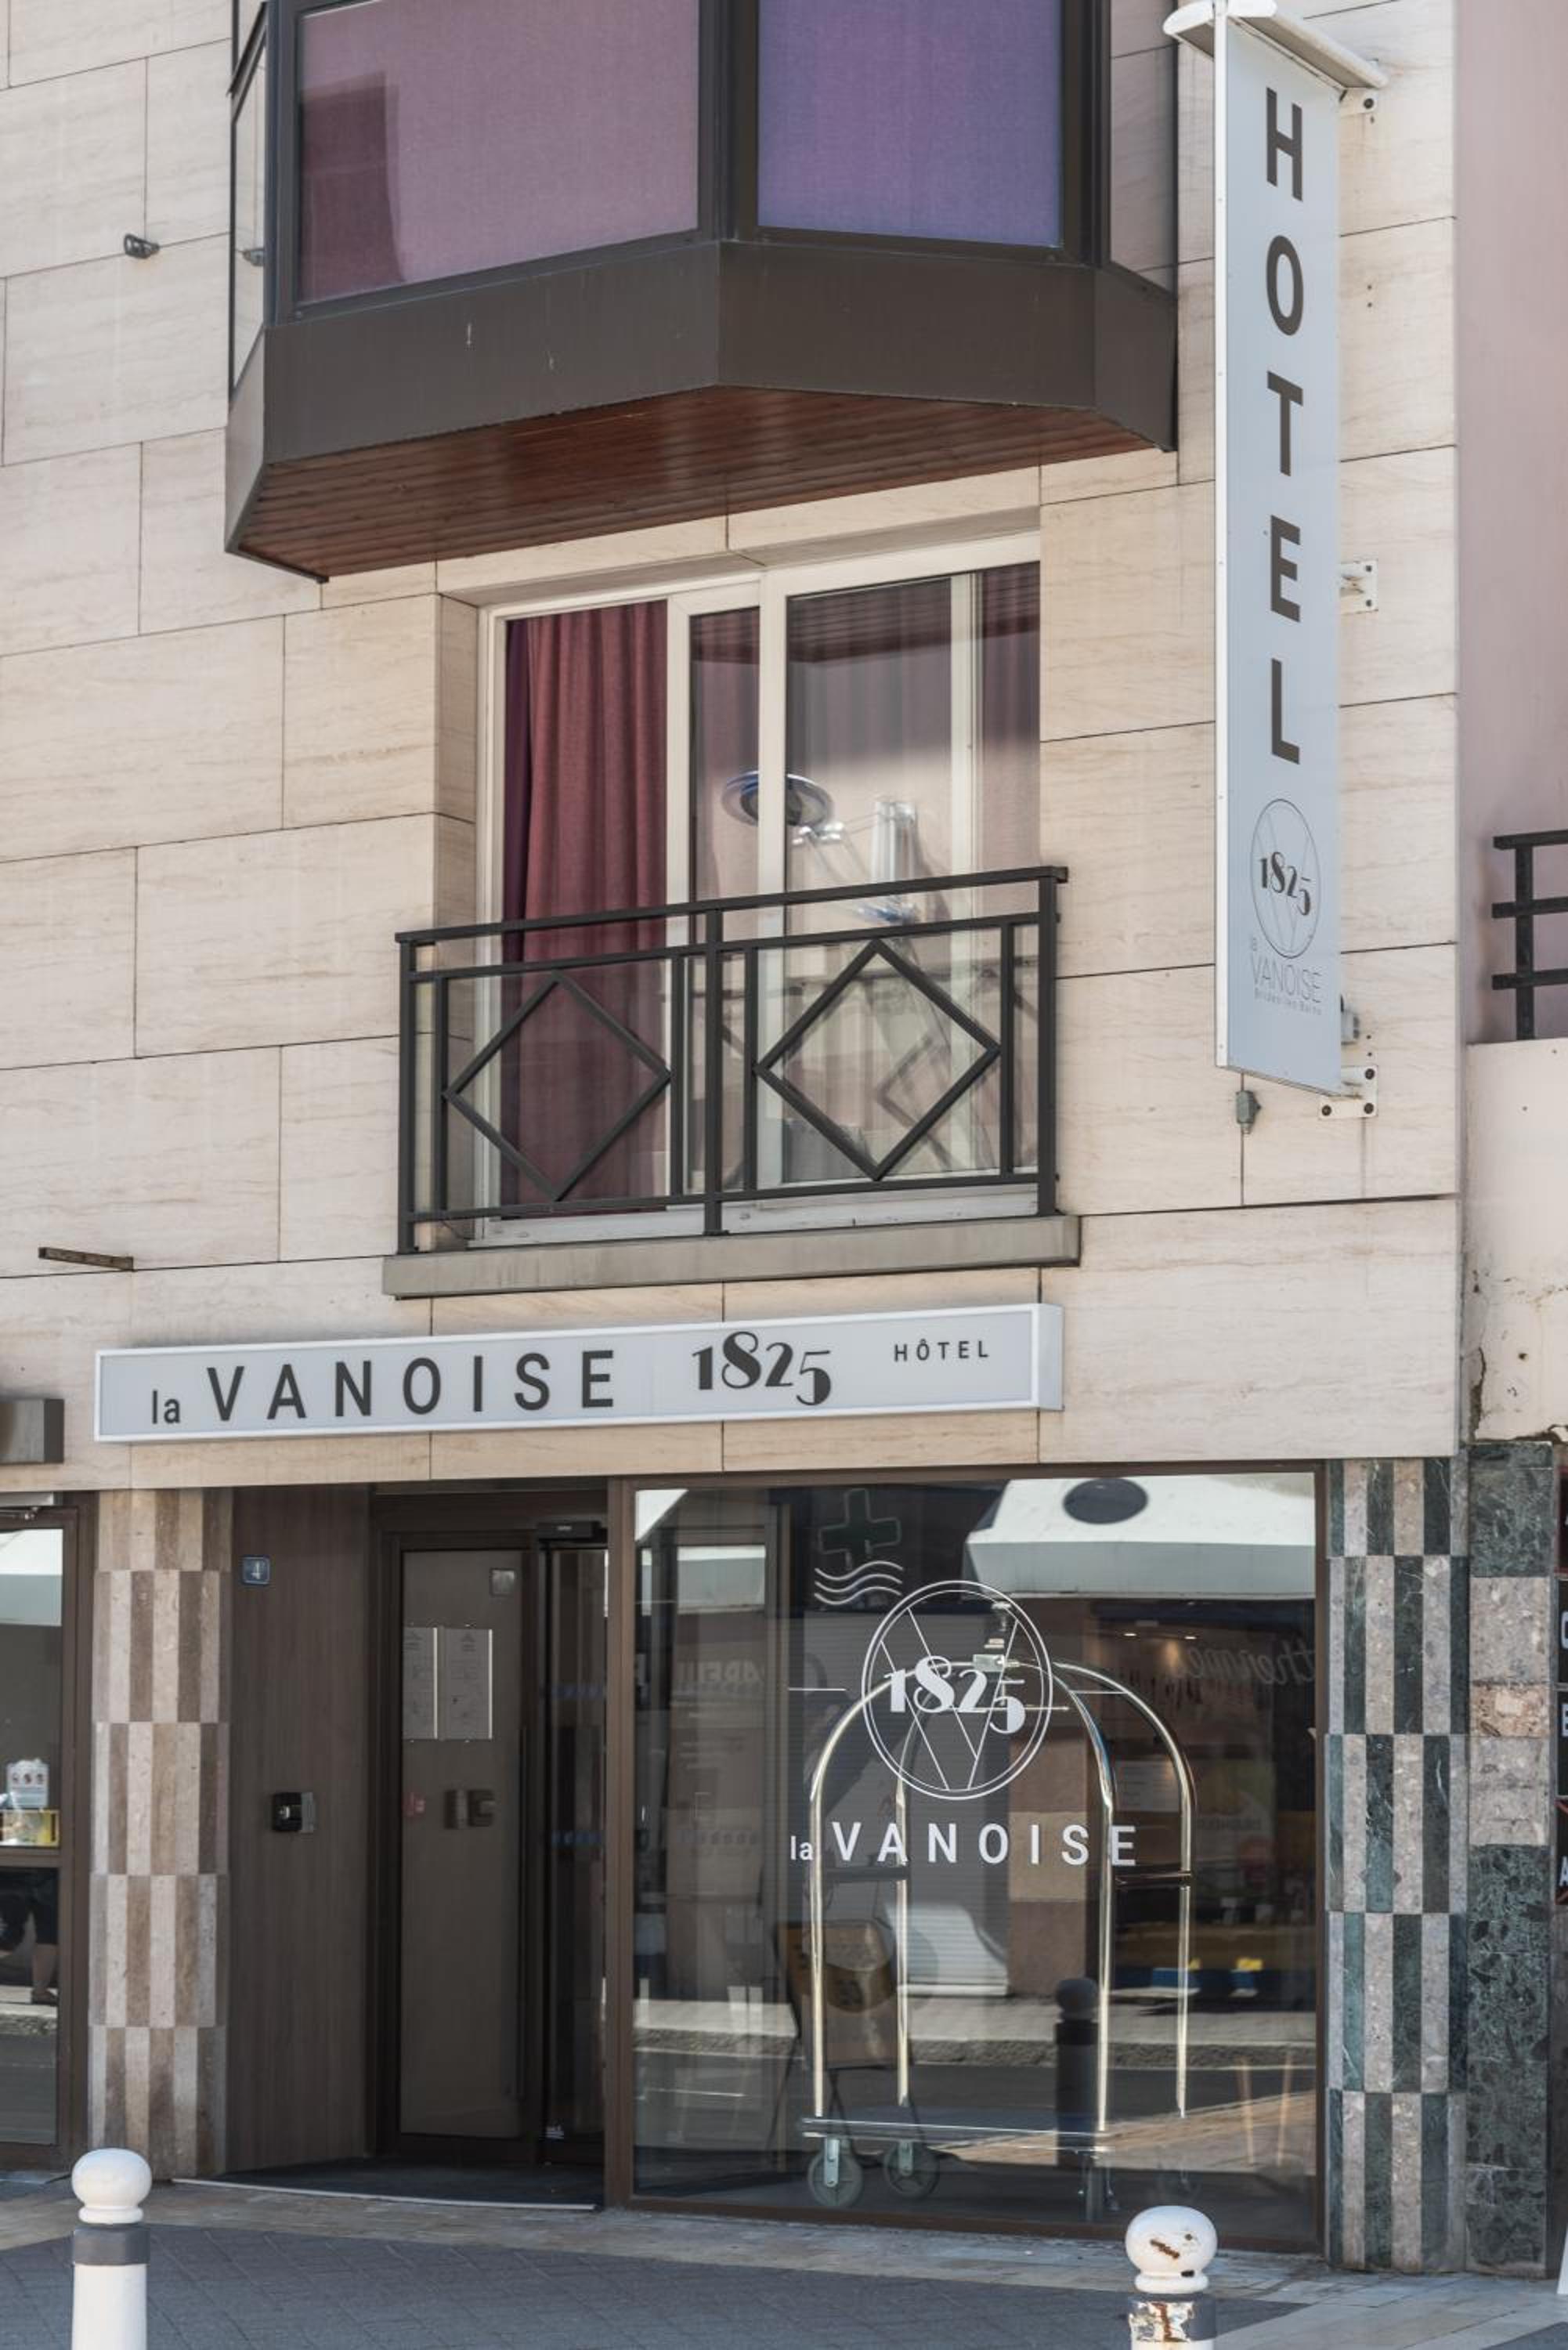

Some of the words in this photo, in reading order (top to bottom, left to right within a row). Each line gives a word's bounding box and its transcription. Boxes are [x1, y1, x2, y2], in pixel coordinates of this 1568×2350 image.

[1266, 87, 1304, 765] HOTEL
[1259, 851, 1312, 916] 1825
[1251, 954, 1322, 1003] VANOISE
[152, 1389, 181, 1425] la
[207, 1349, 614, 1421] VANOISE
[692, 1331, 832, 1405] 1825
[894, 1338, 989, 1361] HÔTEL
[883, 1655, 1027, 1734] 1825
[790, 1835, 814, 1861] la
[832, 1821, 1137, 1866] VANOISE
